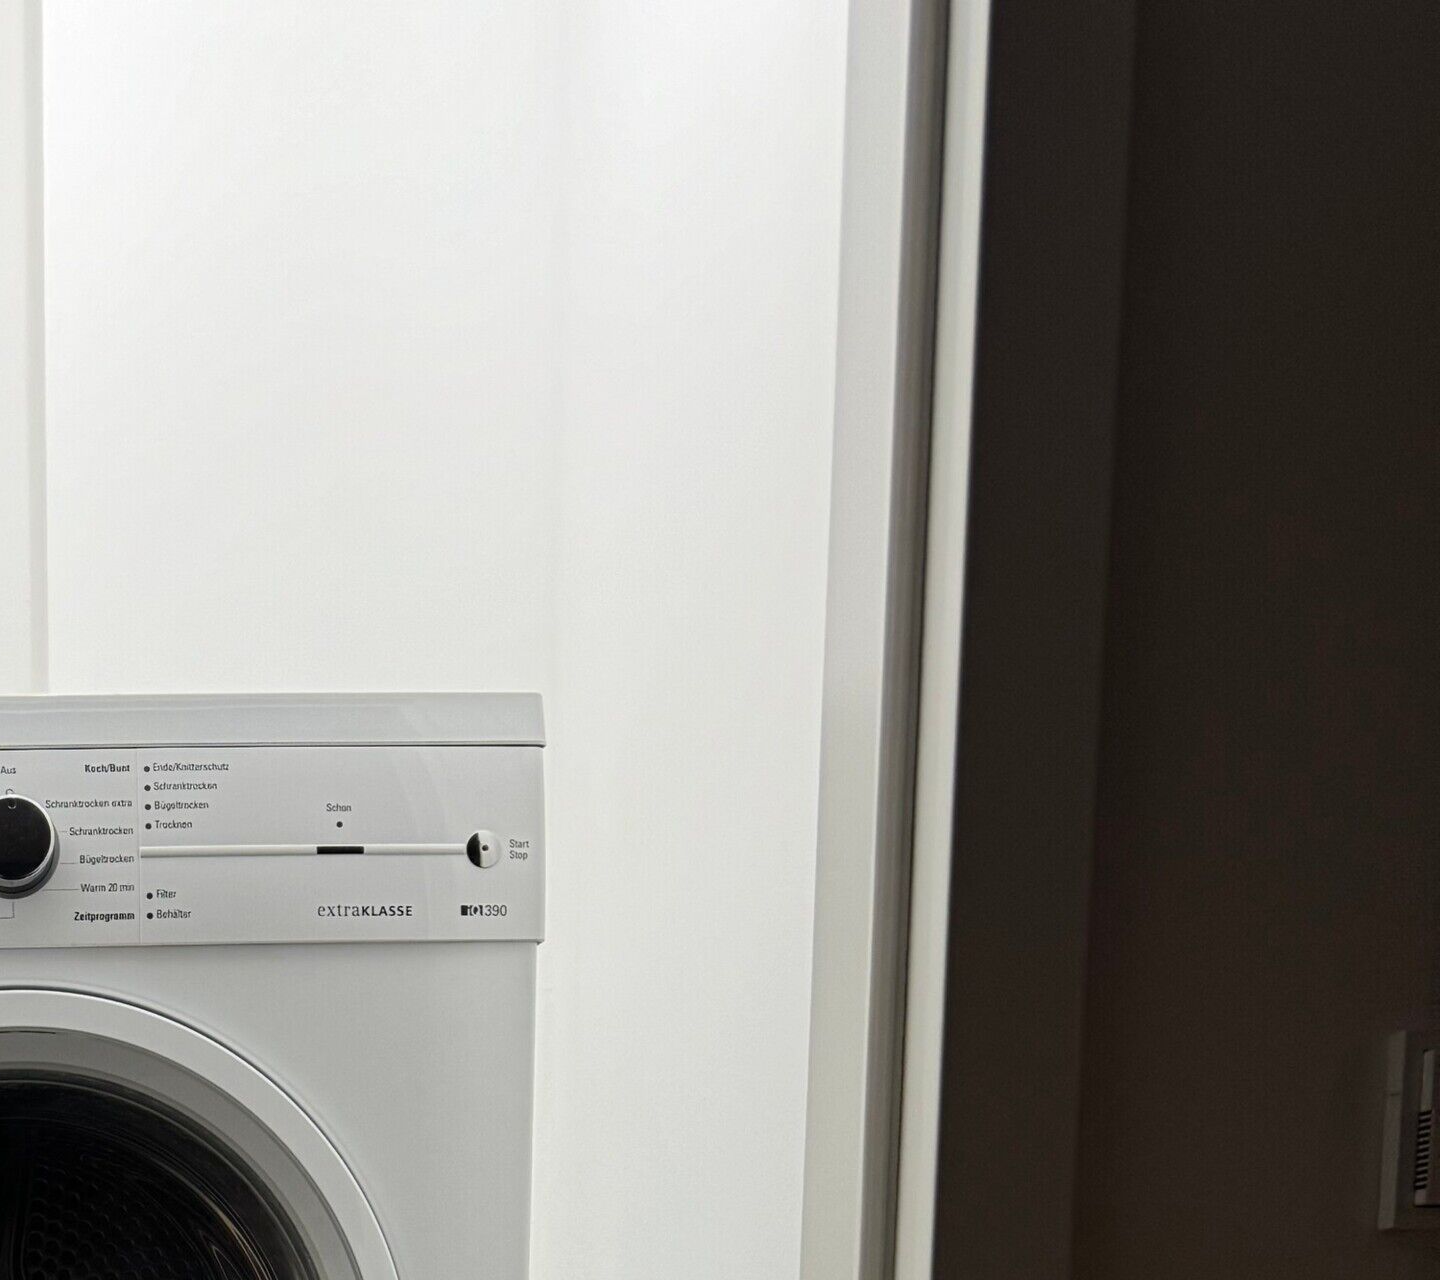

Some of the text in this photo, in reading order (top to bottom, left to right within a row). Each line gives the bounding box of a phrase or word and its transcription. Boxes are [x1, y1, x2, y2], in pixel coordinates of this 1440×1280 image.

[0, 766, 17, 775] Aus
[153, 782, 218, 791] Schranktrocken
[45, 799, 109, 809] Schranktrocken
[326, 803, 352, 812] Schon
[155, 820, 193, 829] Trocknen
[69, 826, 134, 836] Schranktrocken
[510, 839, 530, 849] Start
[79, 854, 135, 865] Bügeltrocken
[510, 850, 528, 860] Stop
[80, 883, 135, 892] Warm 20 min
[156, 889, 177, 898] Filter
[317, 904, 413, 917] extraKLASSE
[74, 911, 135, 922] Zeitprogramm
